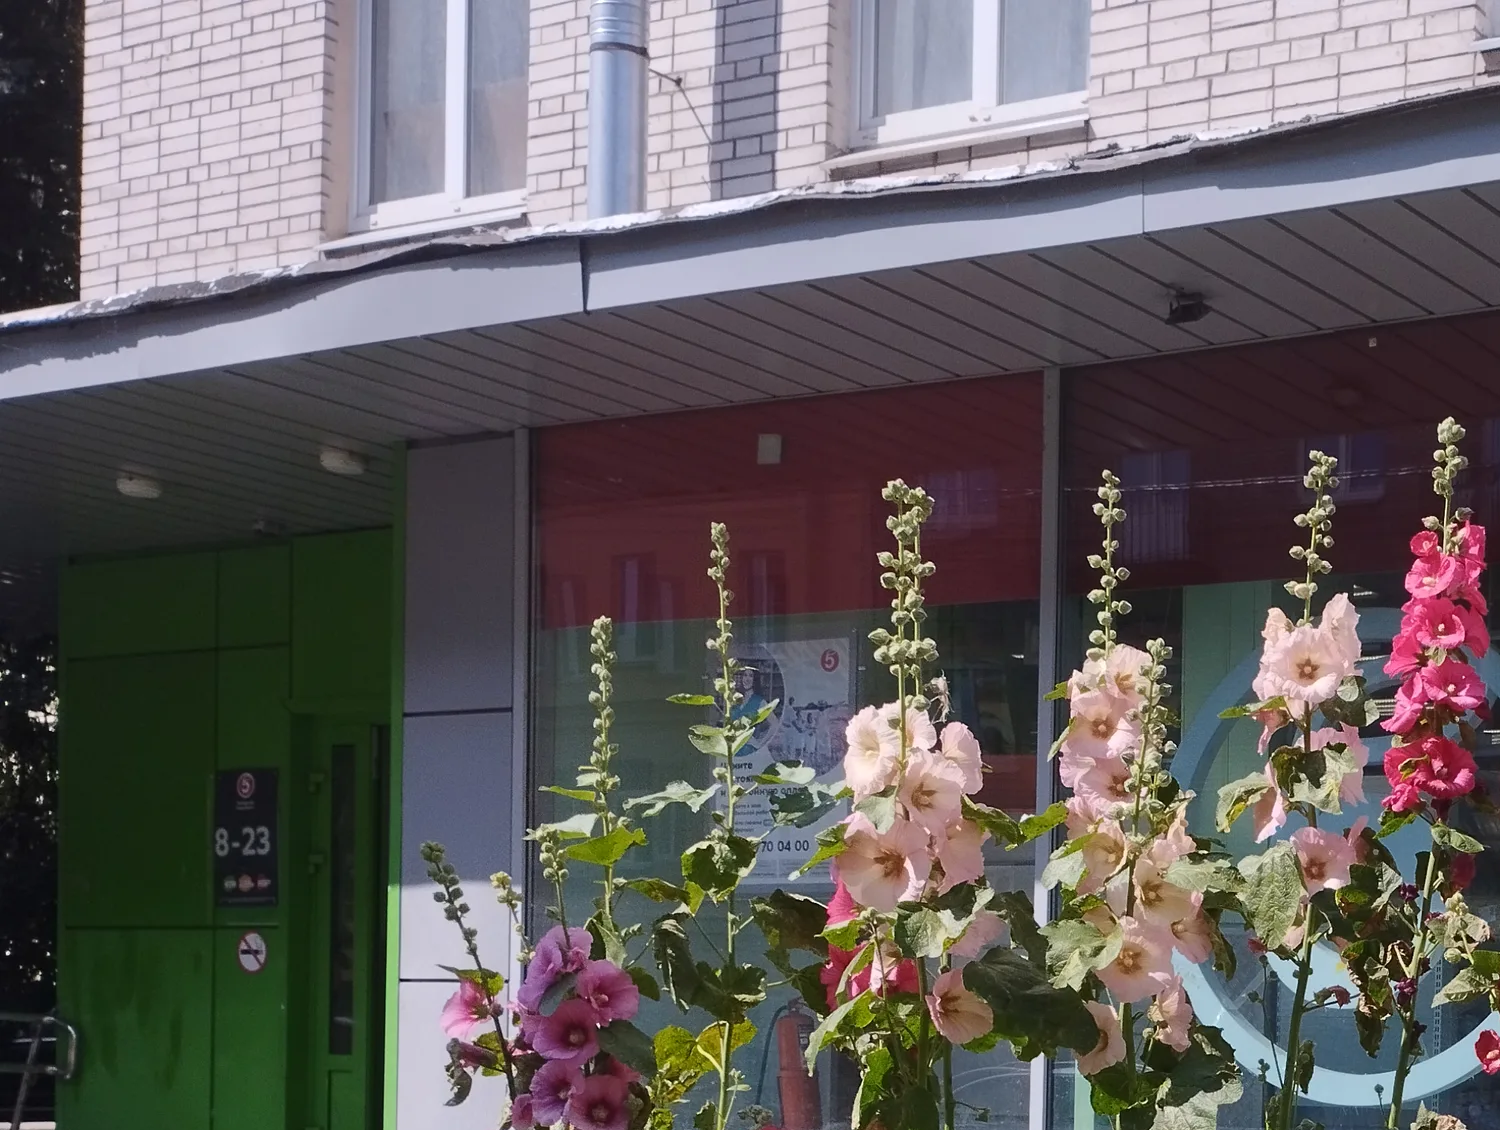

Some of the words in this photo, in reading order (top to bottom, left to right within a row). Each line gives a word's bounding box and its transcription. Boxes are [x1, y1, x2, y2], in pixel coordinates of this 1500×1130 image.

[215, 826, 270, 856] 8-23
[777, 840, 791, 852] 04
[794, 839, 810, 852] 00
